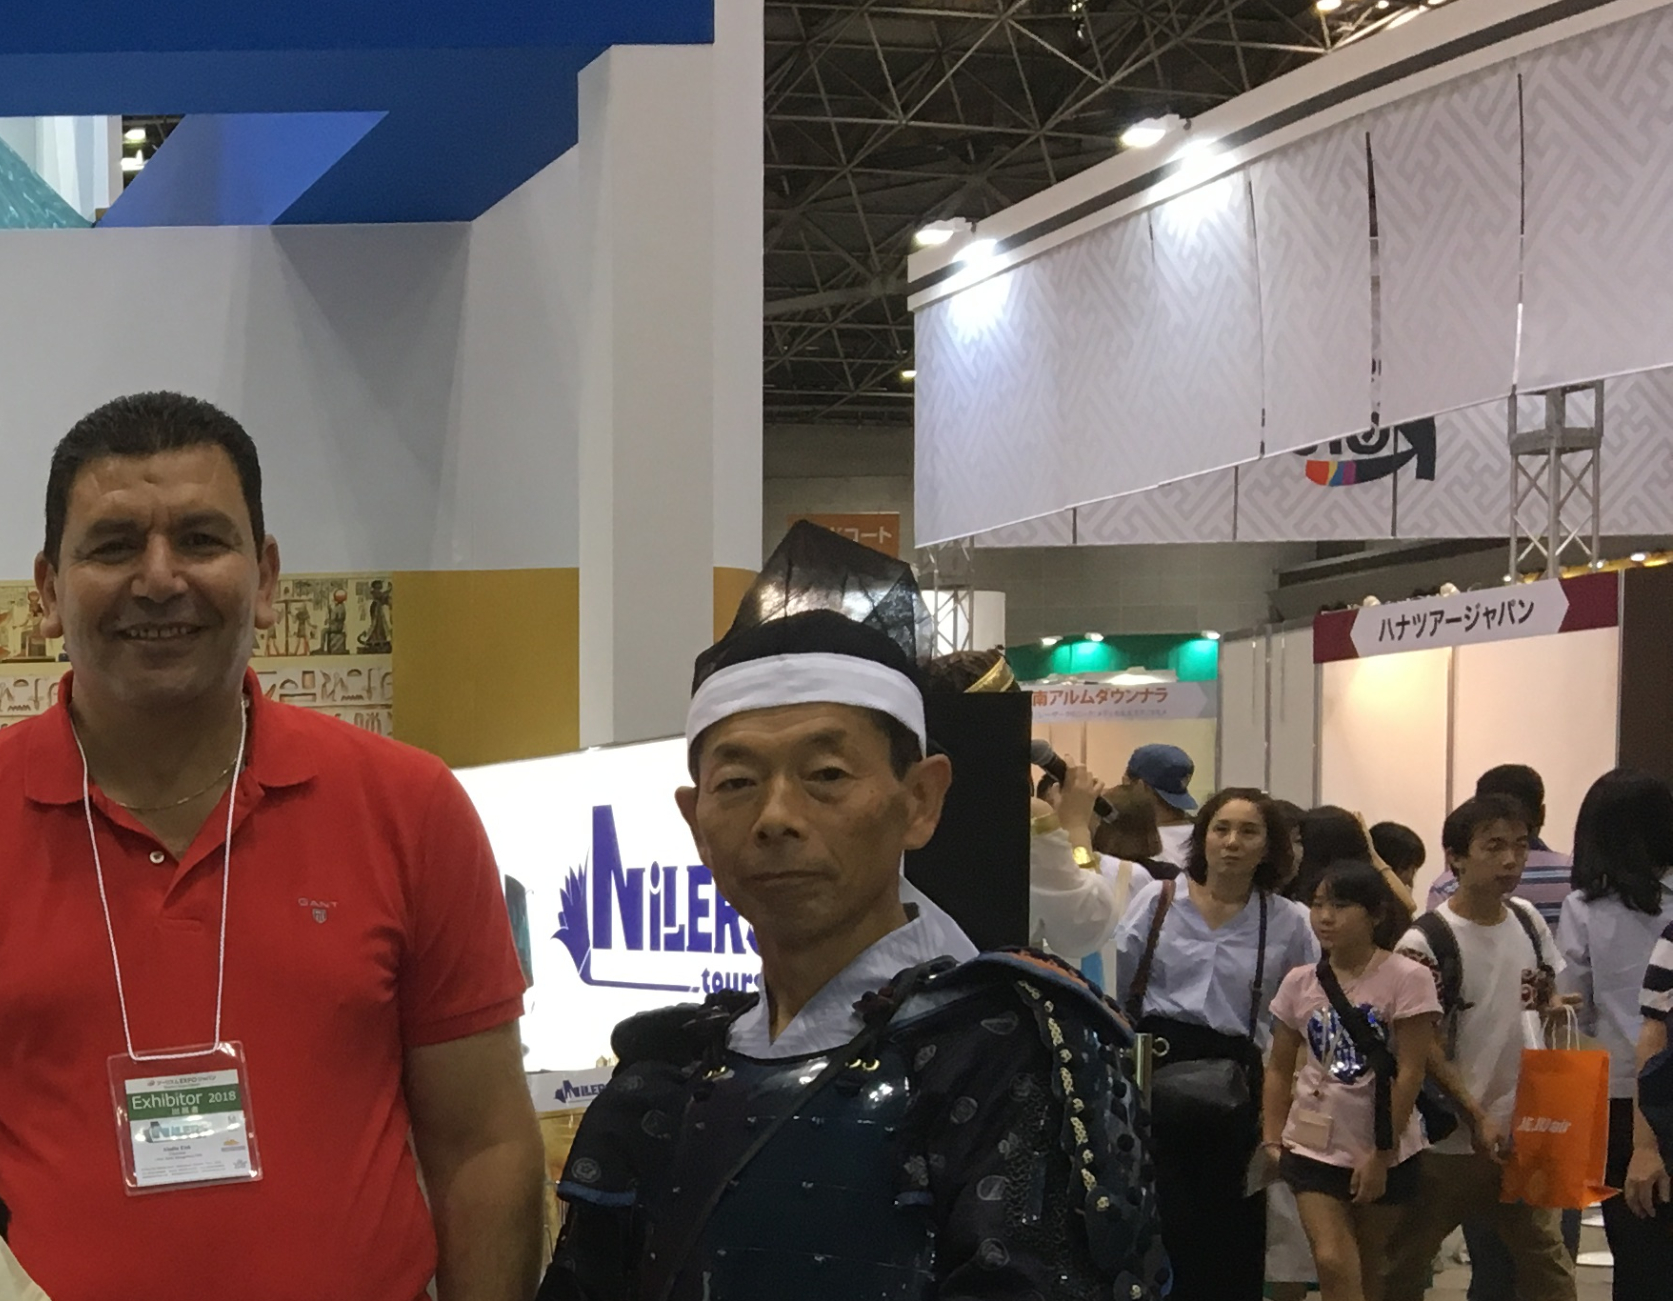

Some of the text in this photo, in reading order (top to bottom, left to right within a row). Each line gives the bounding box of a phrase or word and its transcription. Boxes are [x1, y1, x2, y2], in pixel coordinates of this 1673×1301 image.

[830, 525, 893, 545] コート
[1378, 599, 1535, 642] ハナツアージャパン
[297, 897, 339, 908] GANT
[132, 1090, 236, 1110] Exhibitor 2018
